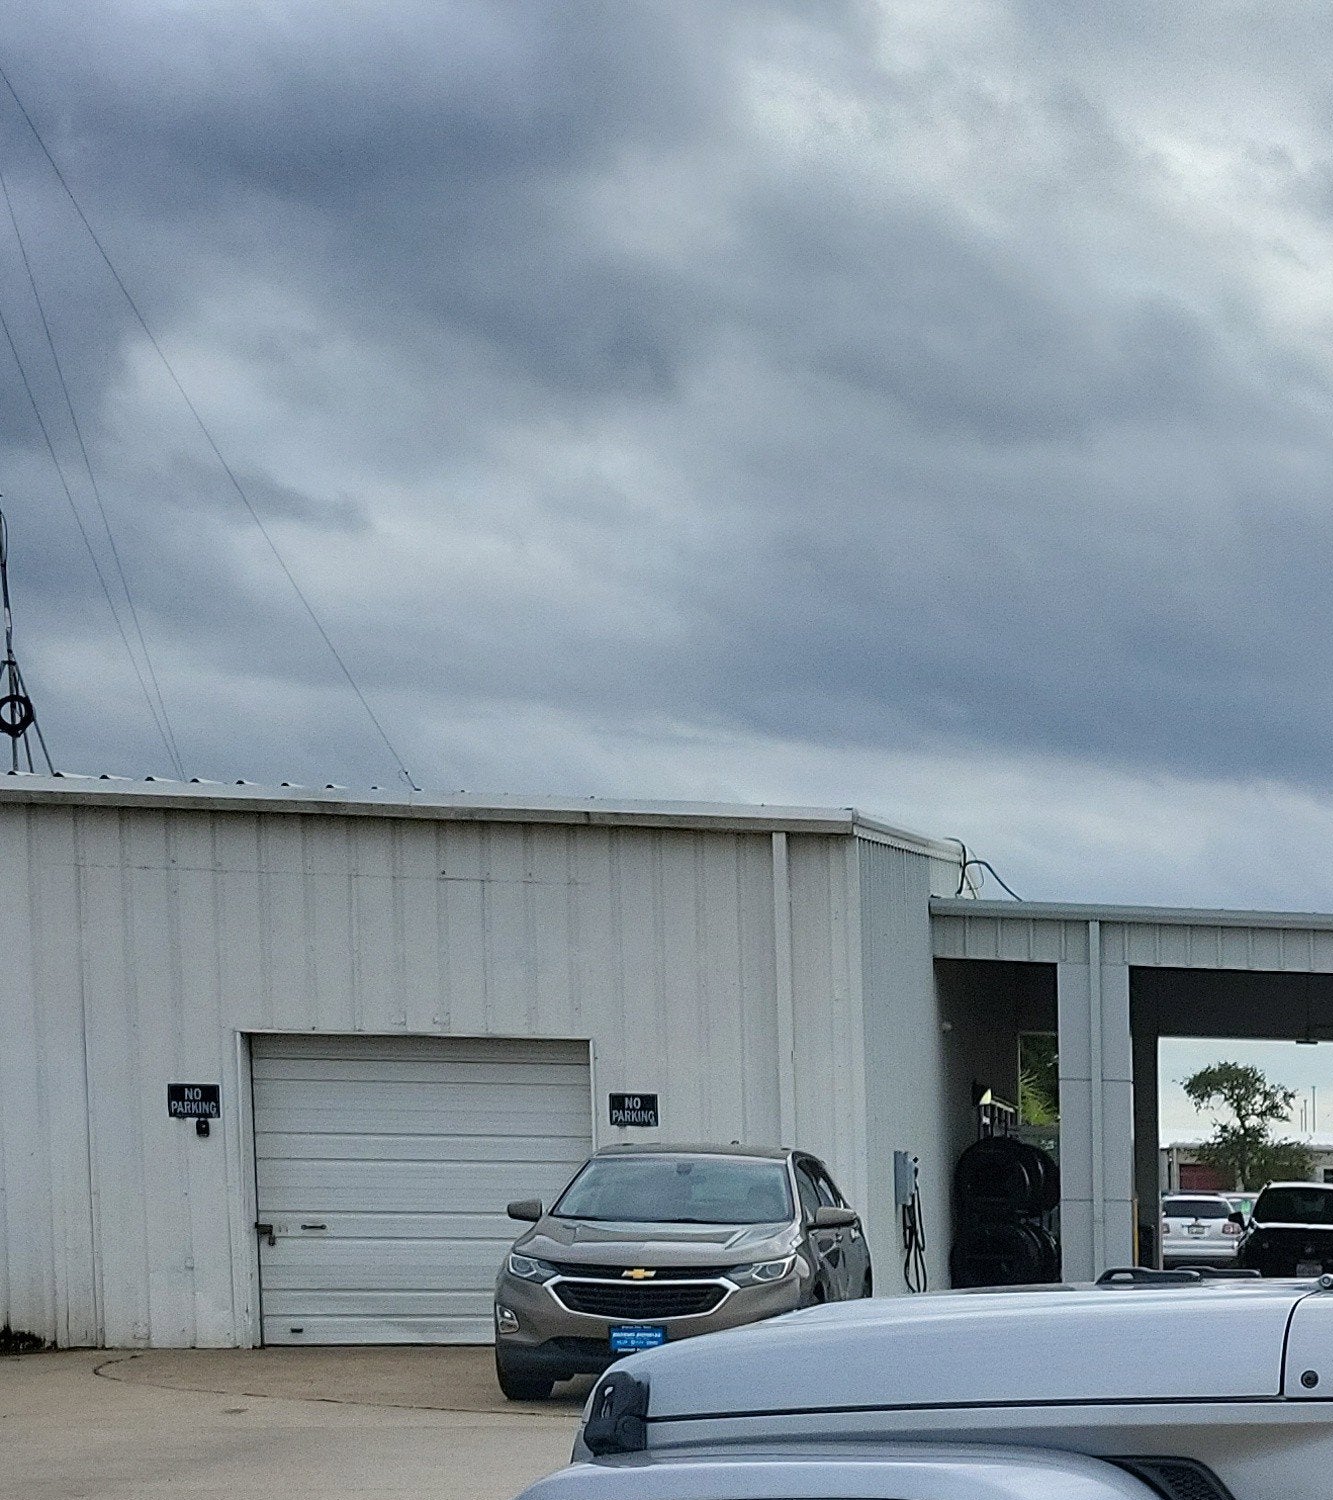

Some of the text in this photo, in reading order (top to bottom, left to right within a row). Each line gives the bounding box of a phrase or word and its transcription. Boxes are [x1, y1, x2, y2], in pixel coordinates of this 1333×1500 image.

[185, 1088, 202, 1100] NO
[171, 1101, 217, 1114] PARKING
[625, 1096, 641, 1109] NO
[612, 1109, 655, 1123] PARKING
